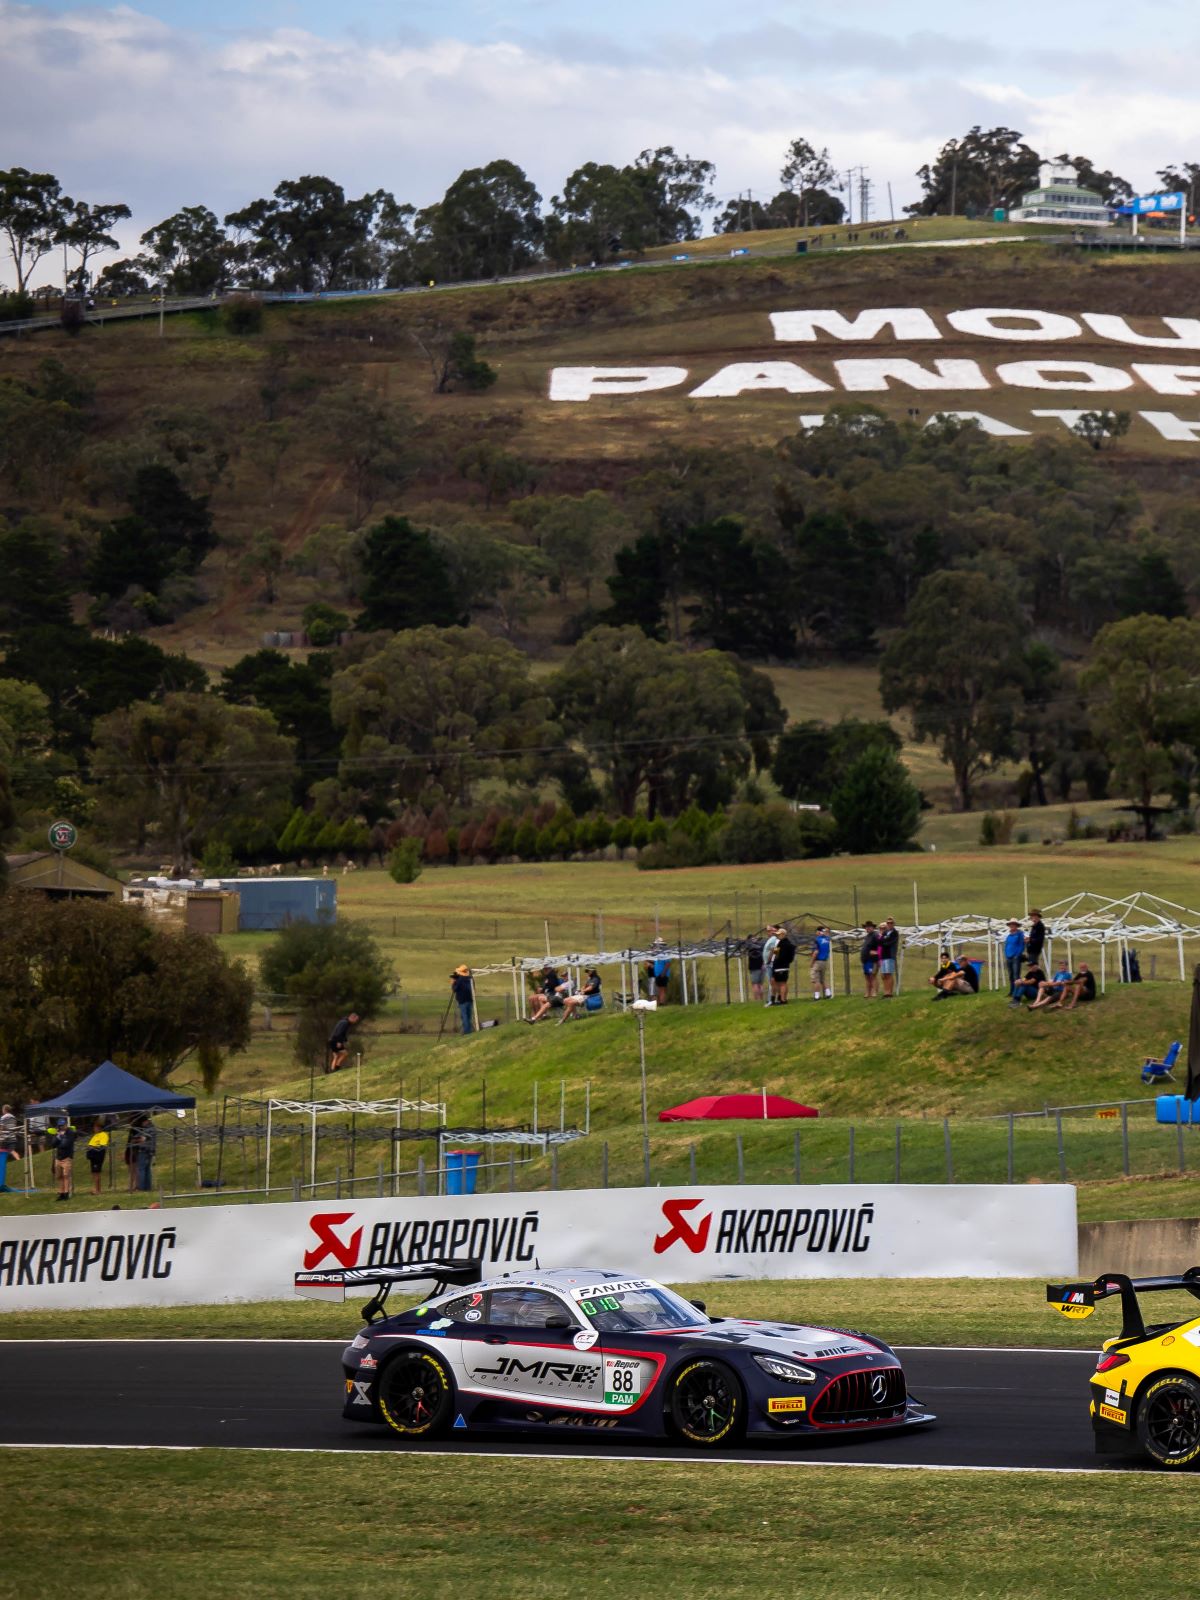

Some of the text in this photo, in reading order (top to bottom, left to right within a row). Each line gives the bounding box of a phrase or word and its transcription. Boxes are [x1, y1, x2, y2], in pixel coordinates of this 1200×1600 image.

[579, 1281, 651, 1297] FANATEC
[1061, 1305, 1088, 1314] WRT
[472, 1357, 575, 1383] JMR
[614, 1359, 641, 1370] Repco
[612, 1369, 634, 1392] 88
[611, 1394, 635, 1405] PAM
[772, 1400, 803, 1410] PIRELLI
